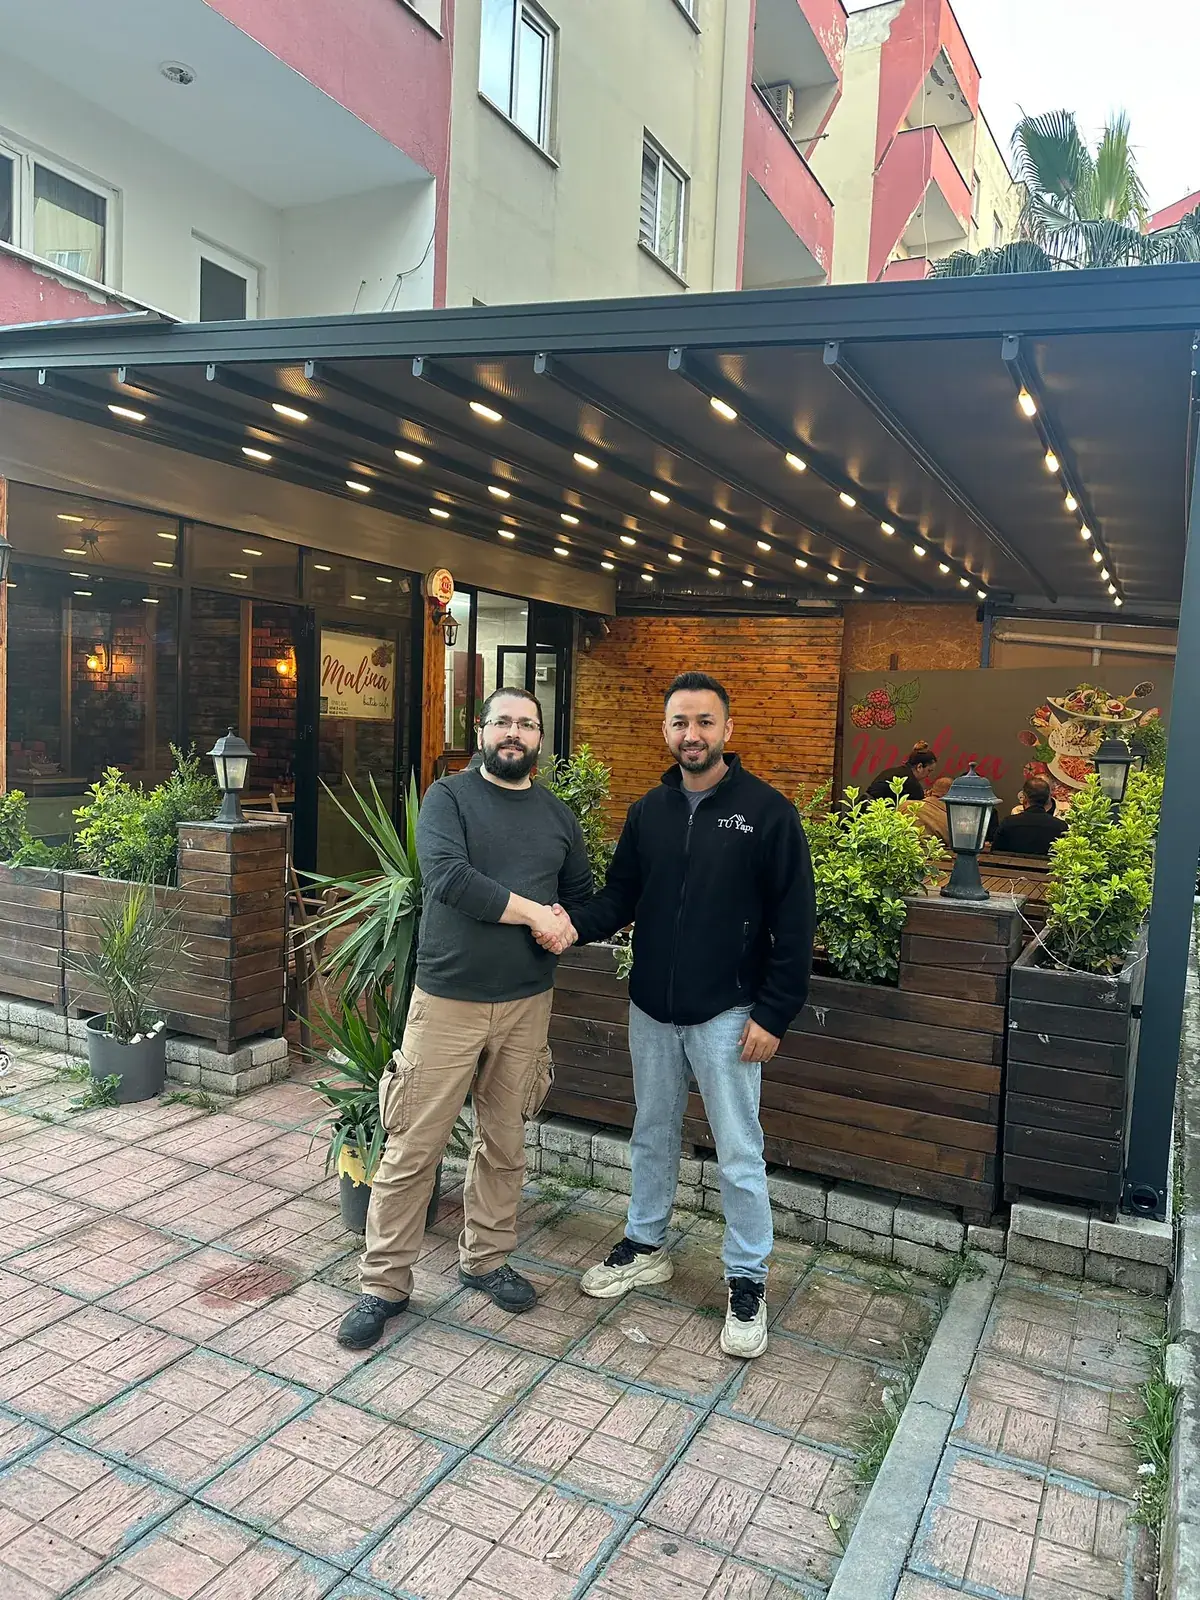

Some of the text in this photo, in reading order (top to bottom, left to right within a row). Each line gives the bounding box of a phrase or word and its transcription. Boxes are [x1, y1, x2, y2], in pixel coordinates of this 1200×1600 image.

[322, 654, 390, 695] Malina
[850, 725, 1010, 786] Mlina
[717, 818, 733, 828] TU
